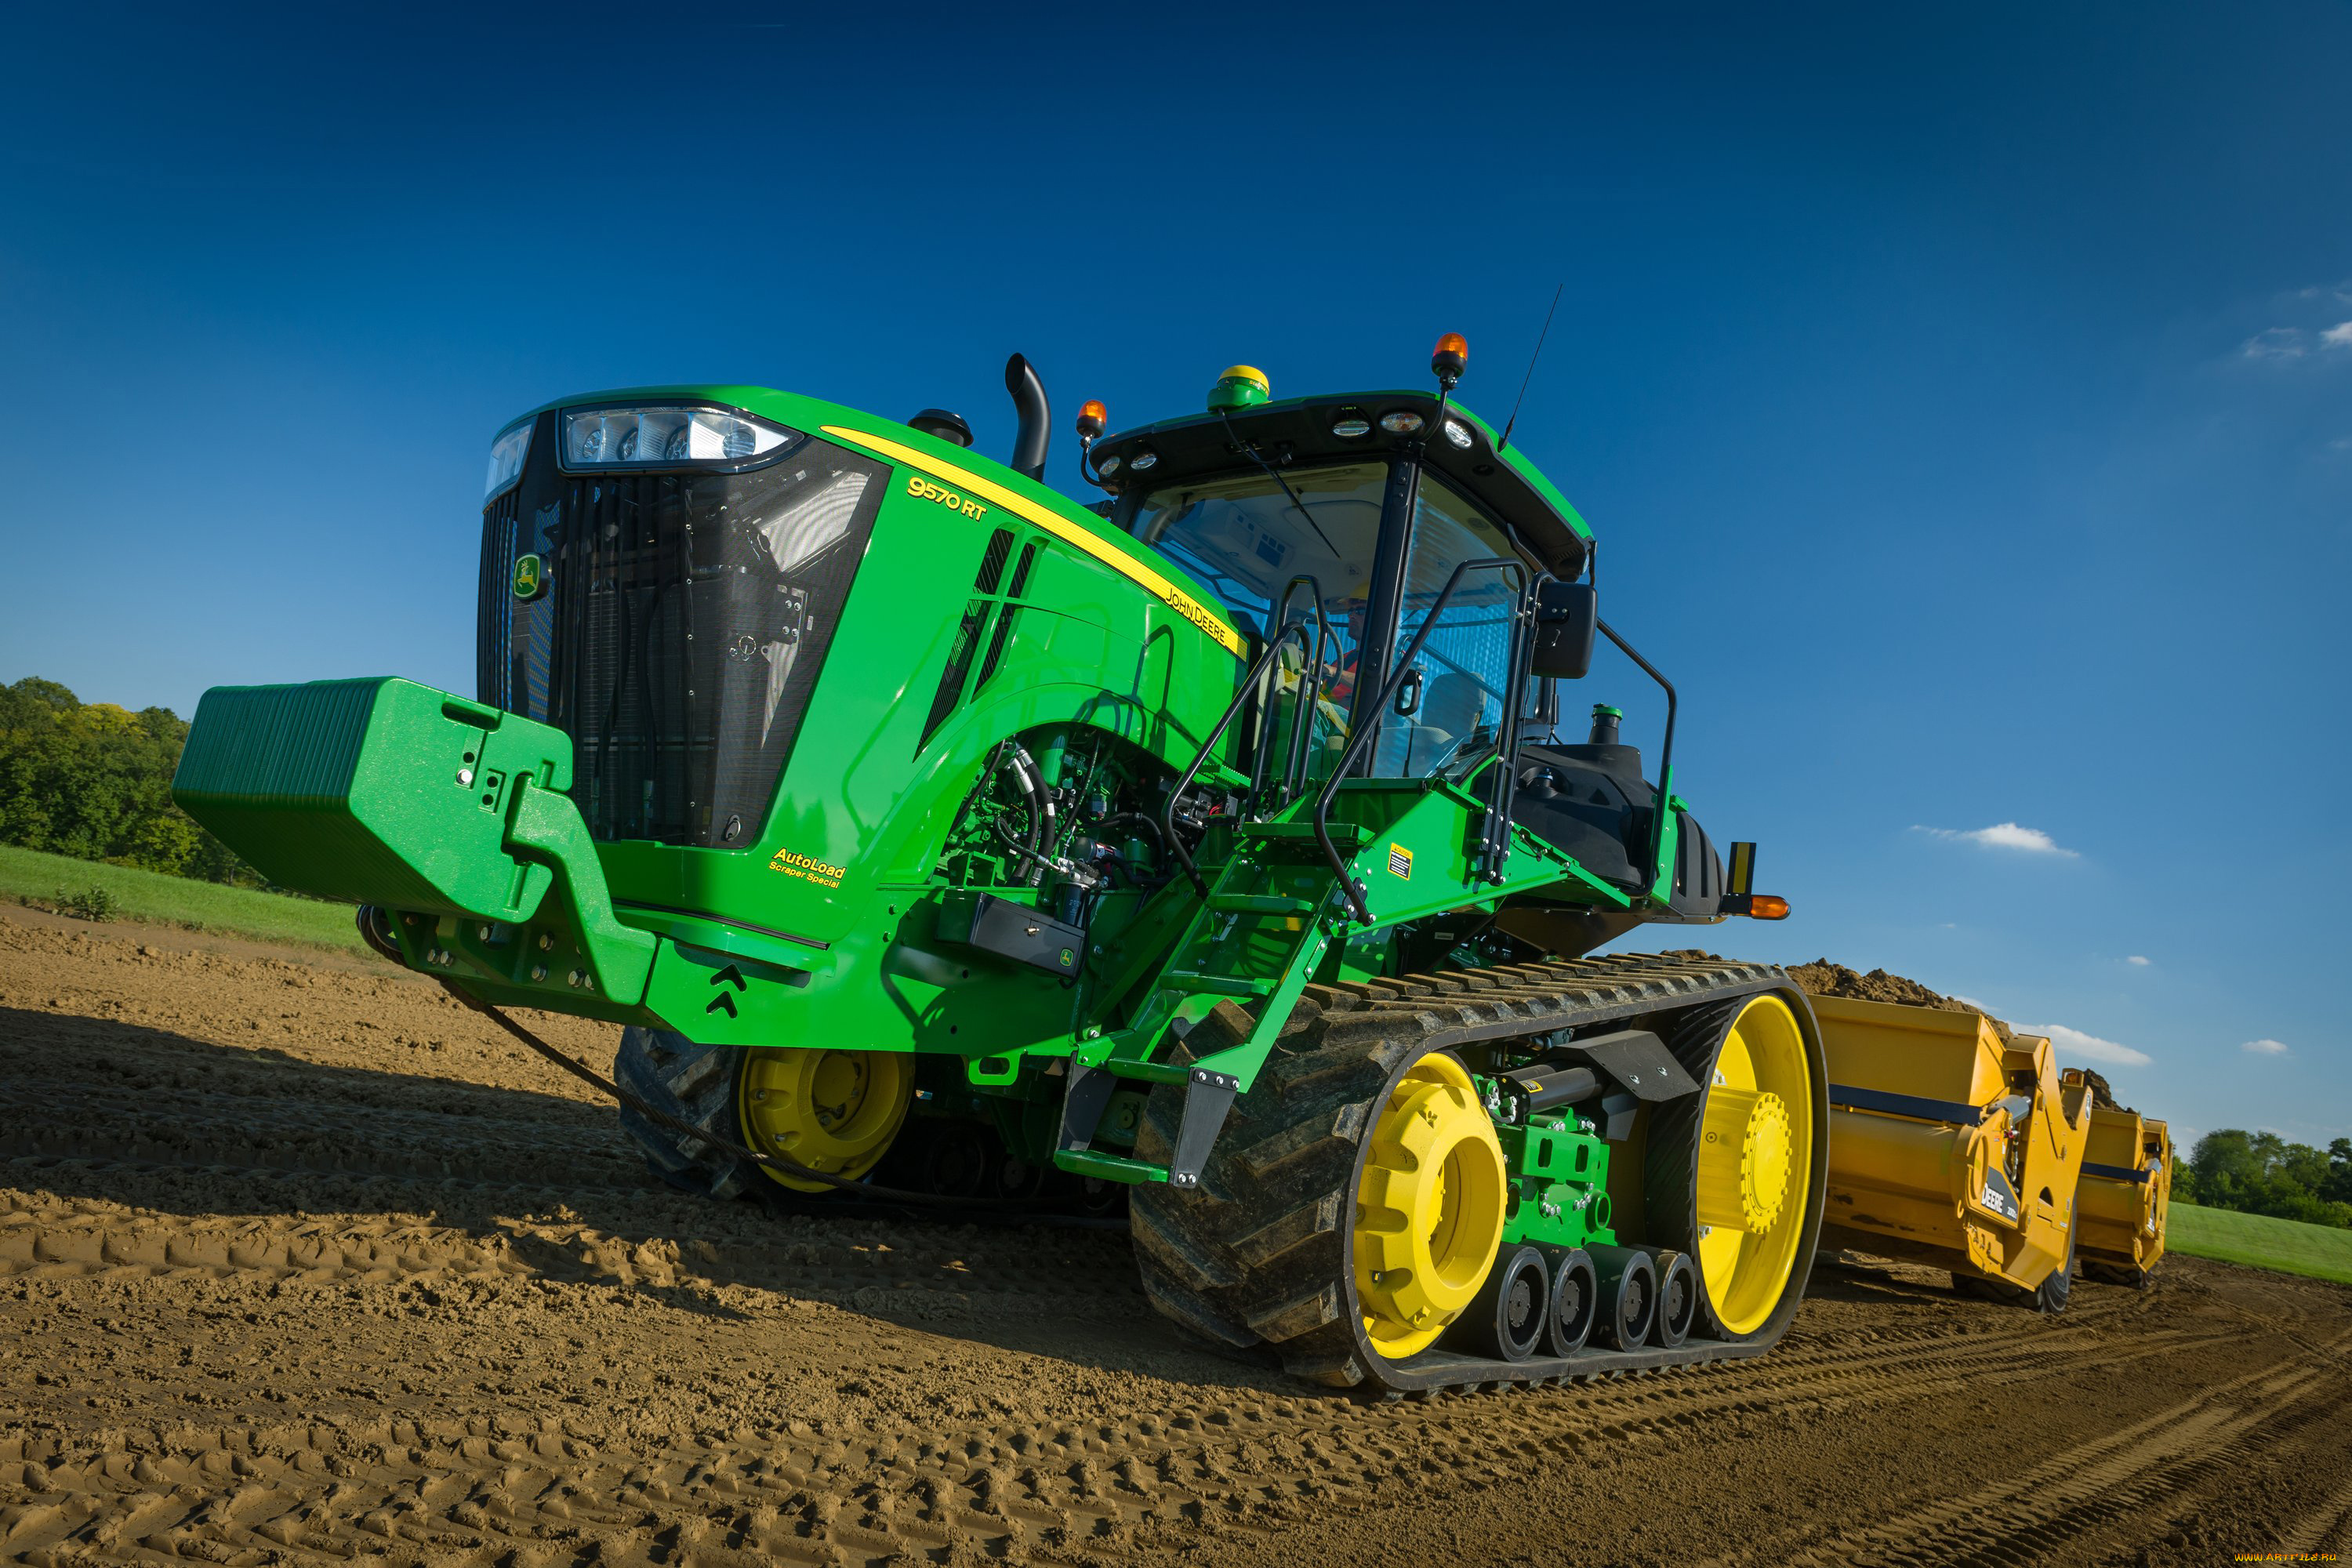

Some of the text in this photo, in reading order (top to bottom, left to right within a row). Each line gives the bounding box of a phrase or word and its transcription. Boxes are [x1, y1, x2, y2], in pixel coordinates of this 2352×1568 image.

[907, 477, 988, 522] 9570 RT
[1165, 588, 1225, 643] JOHN DEERE
[768, 861, 840, 889] Scraper Special
[771, 847, 848, 880] AutoLoad
[1981, 1182, 2005, 1214] DEERE
